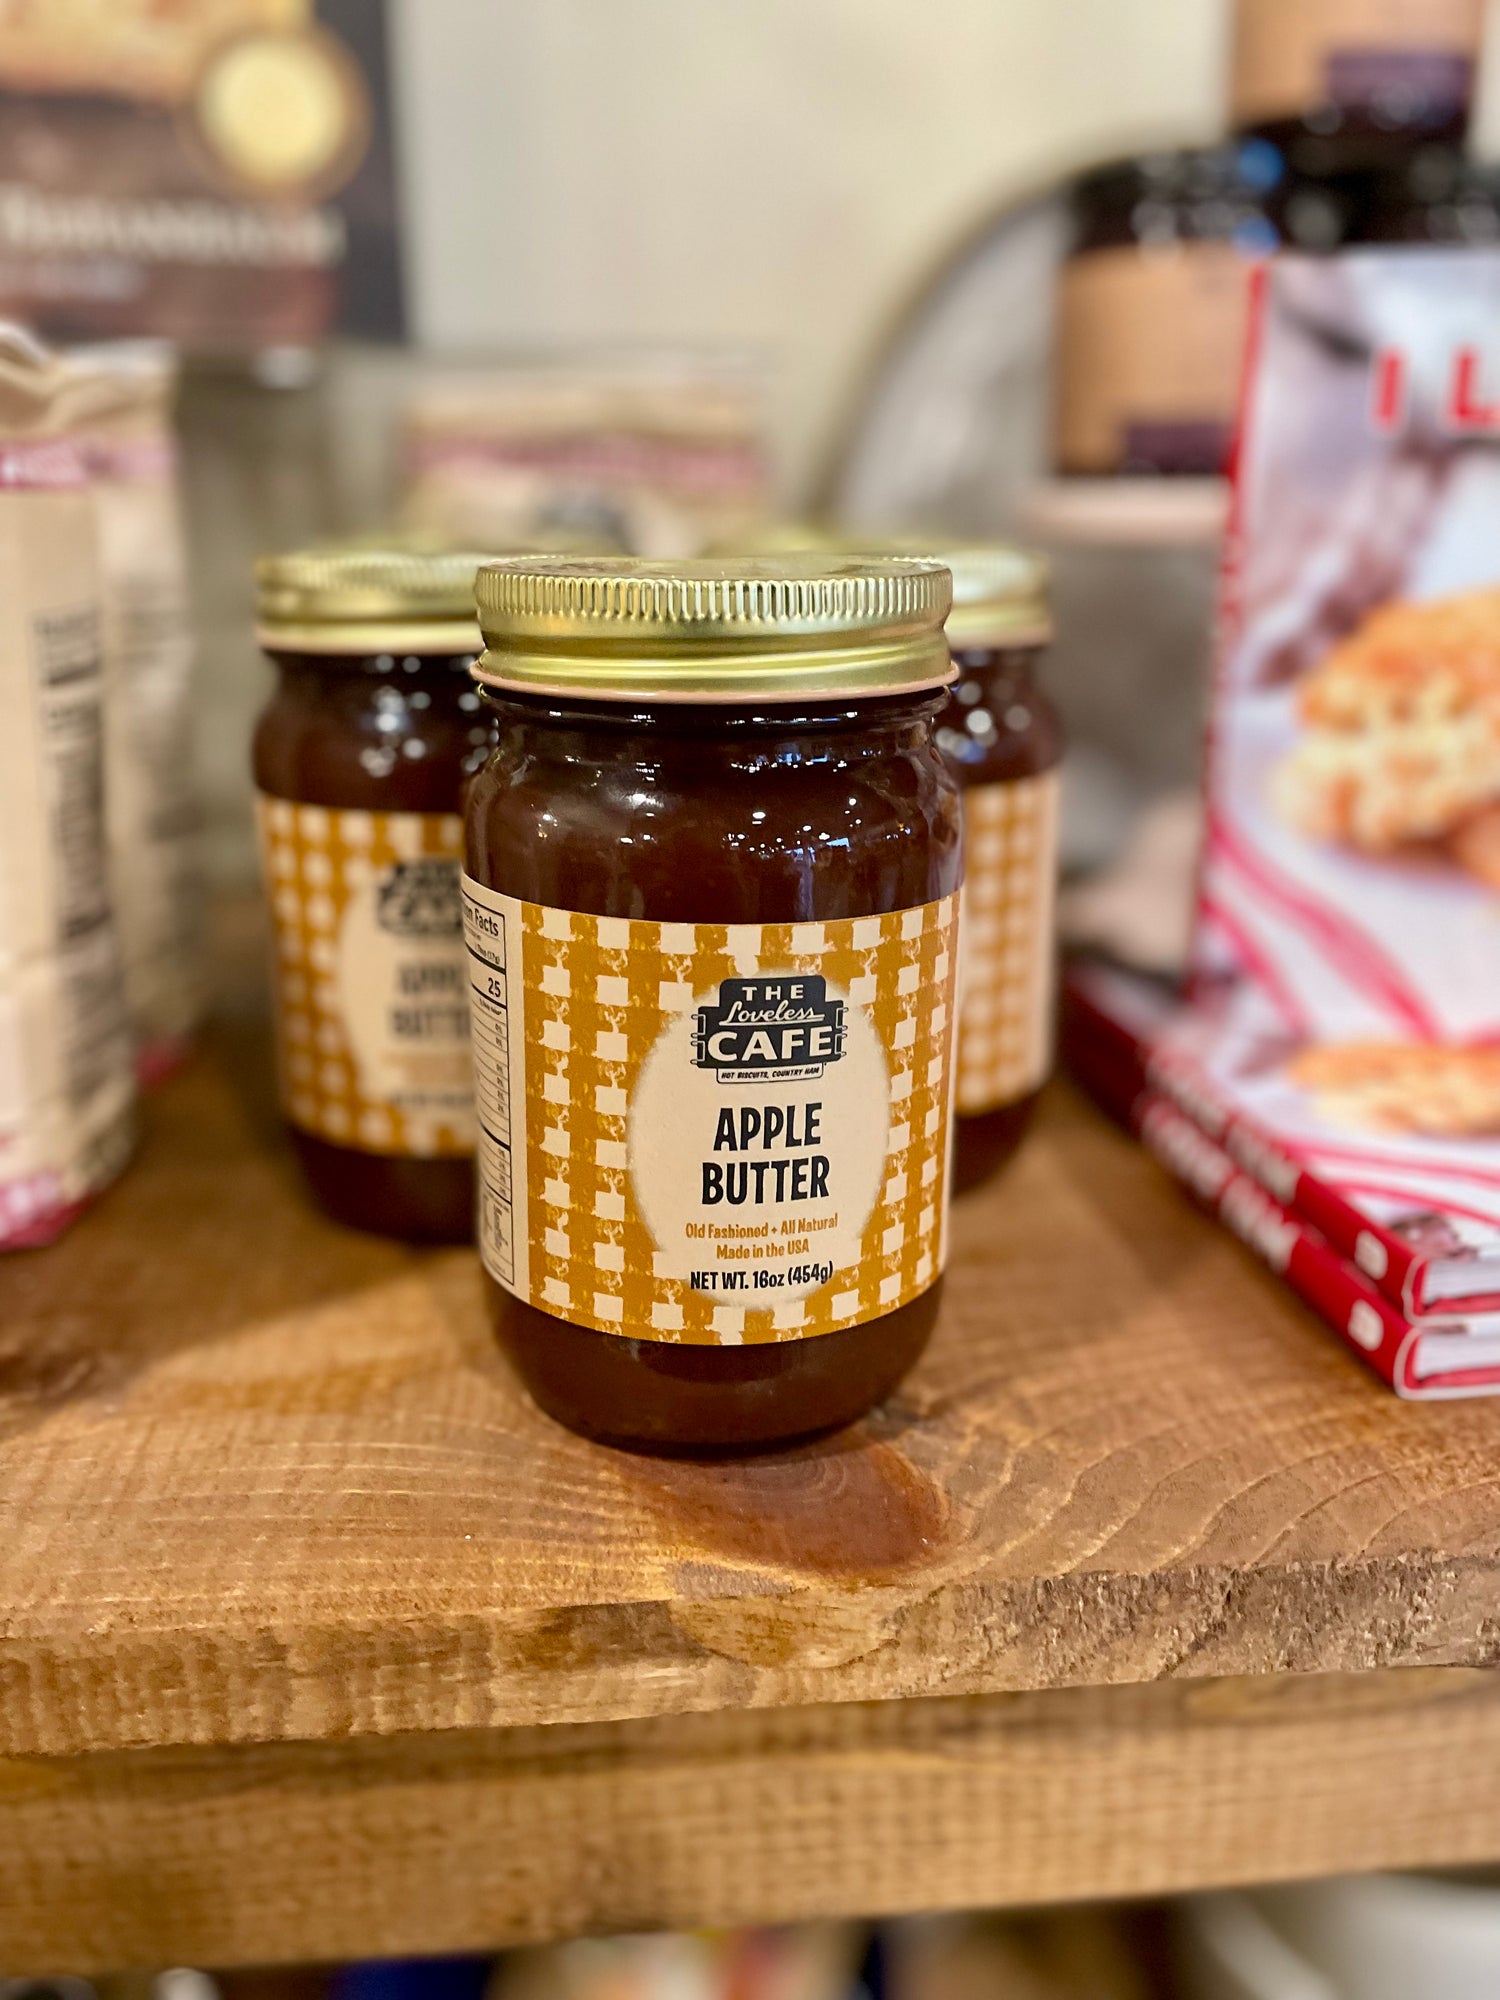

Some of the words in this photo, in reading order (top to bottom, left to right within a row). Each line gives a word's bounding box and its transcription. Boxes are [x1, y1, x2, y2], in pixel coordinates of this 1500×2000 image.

[474, 907, 499, 937] Facts
[488, 977, 501, 998] 25
[741, 983, 805, 1001] THE
[719, 1000, 825, 1027] Loveless
[707, 1025, 833, 1062] CAFE
[721, 1071, 735, 1079] HOT
[771, 1068, 804, 1078] COUNTRY
[713, 1102, 823, 1152] APPLE
[701, 1155, 830, 1206] BUTTER
[685, 1222, 706, 1239] Old
[708, 1221, 769, 1239] Fashioned
[780, 1219, 796, 1236] All
[797, 1212, 838, 1234] Natural
[716, 1243, 750, 1260] Made
[752, 1244, 763, 1258] in
[765, 1242, 785, 1257] the
[787, 1238, 810, 1255] USA
[690, 1271, 719, 1290] NET
[721, 1270, 750, 1290] WT.
[752, 1270, 785, 1289] 16oz
[787, 1260, 834, 1285] (454g)
